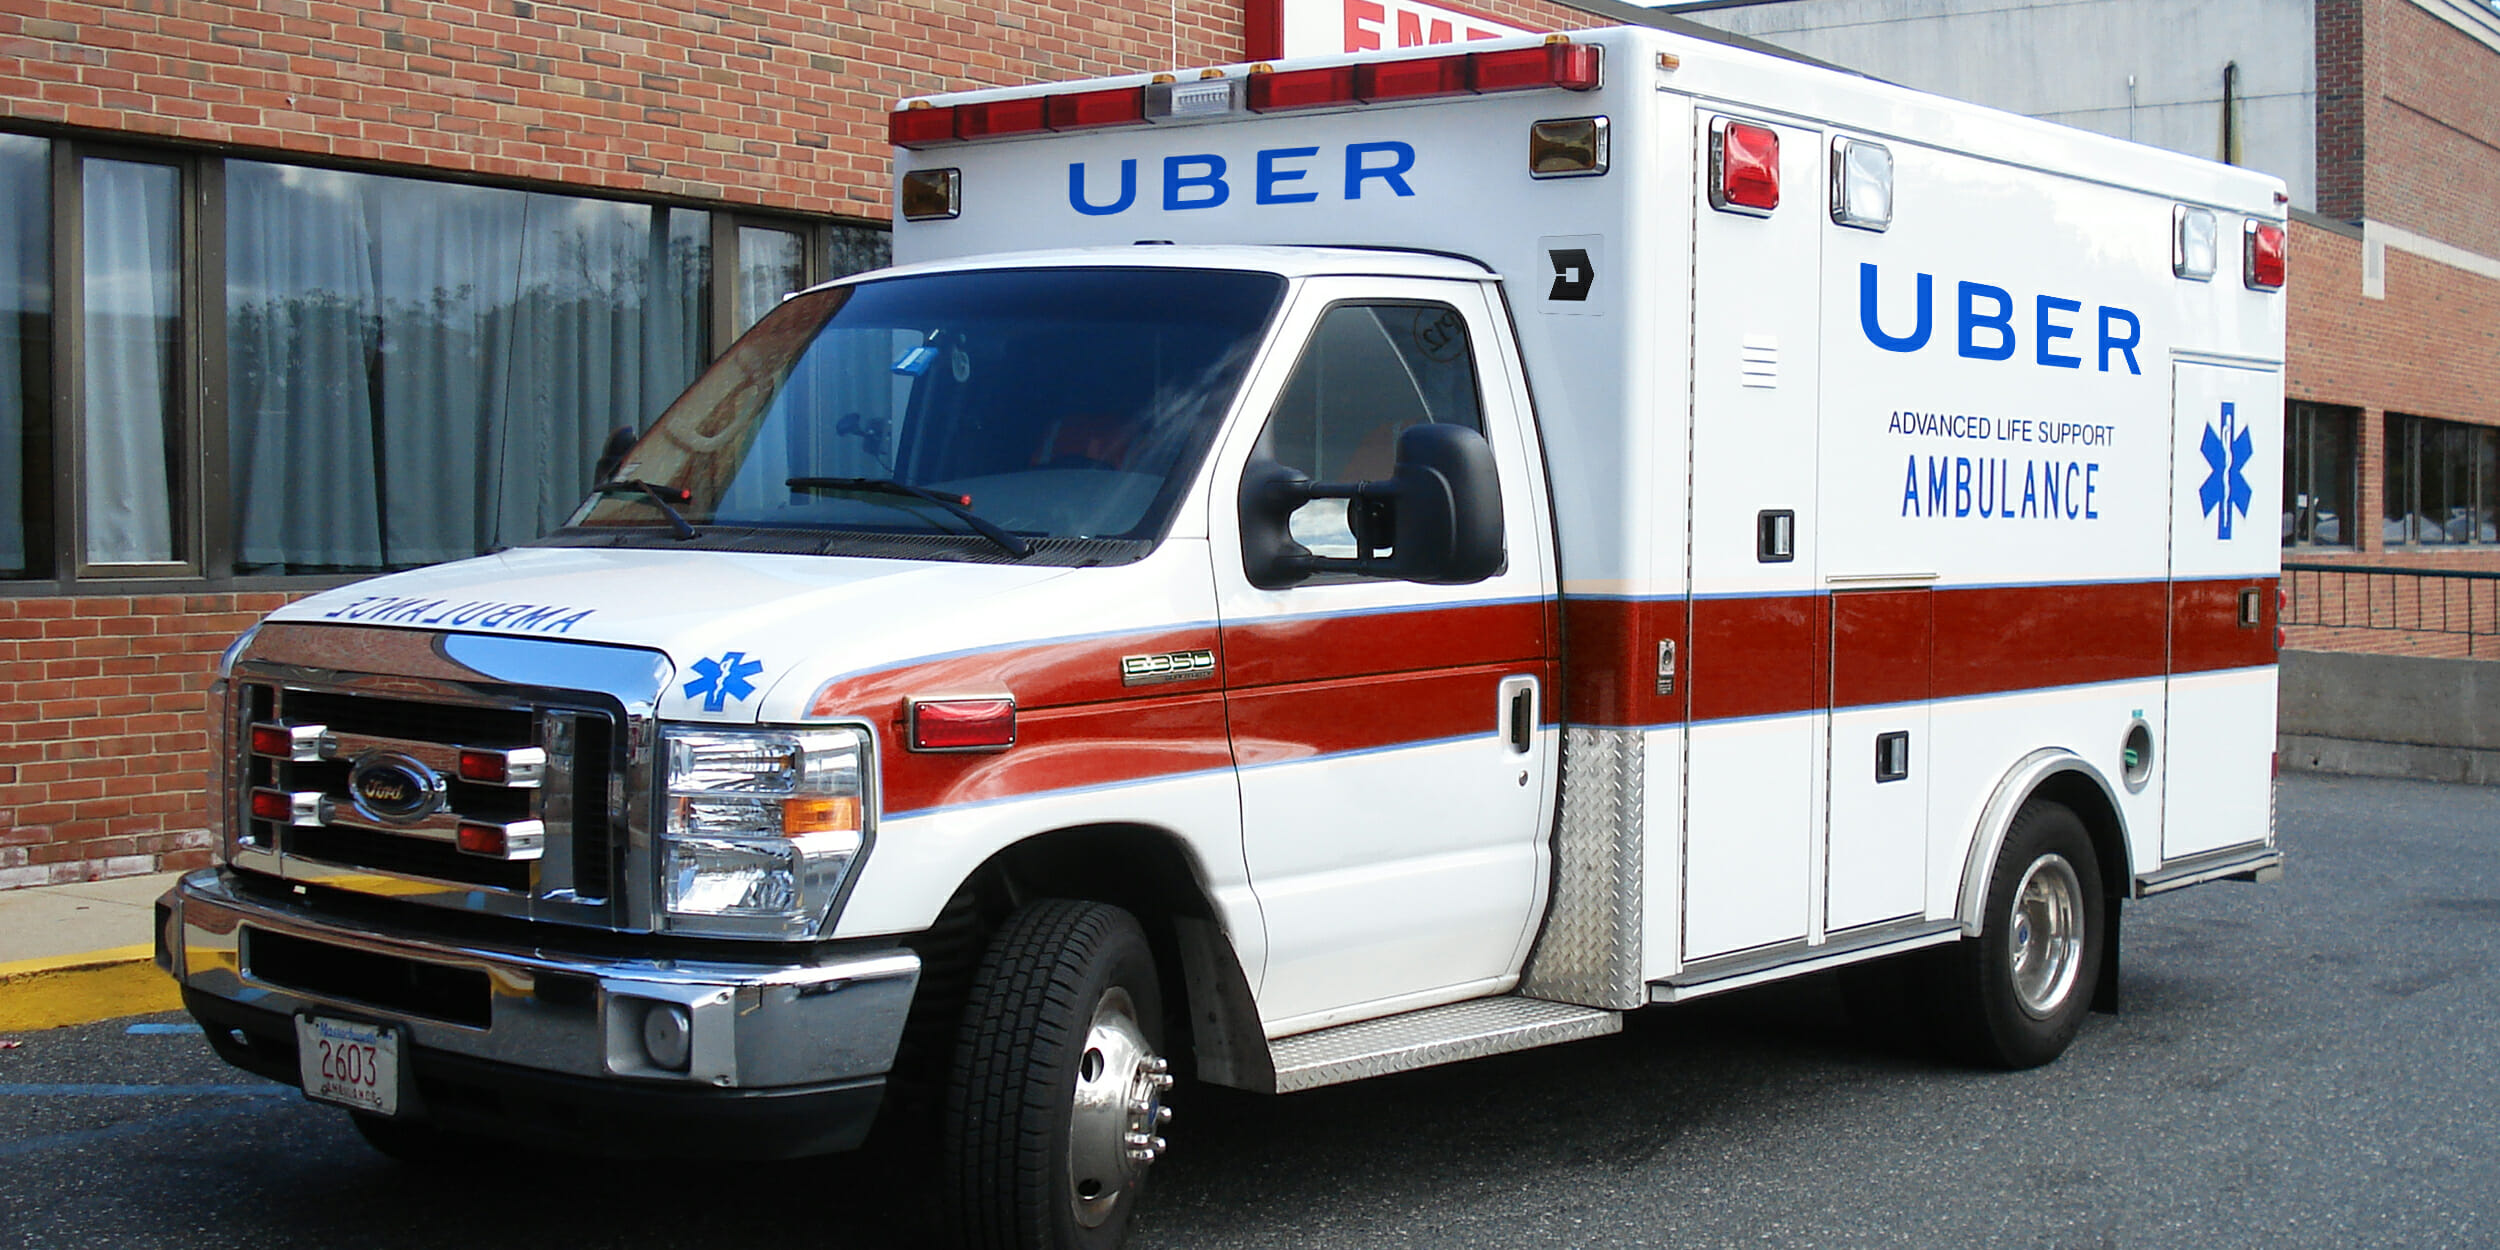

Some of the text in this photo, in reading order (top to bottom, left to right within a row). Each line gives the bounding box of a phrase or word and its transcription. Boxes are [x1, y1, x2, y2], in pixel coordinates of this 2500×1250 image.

[1069, 141, 1416, 216] UBER
[1860, 262, 2142, 376] UBER
[1888, 410, 2116, 447] ADVANCED LIFE SUPPORT
[1901, 454, 2100, 521] AMBULANCE
[364, 779, 405, 801] Ford
[319, 1039, 377, 1087] 2603
